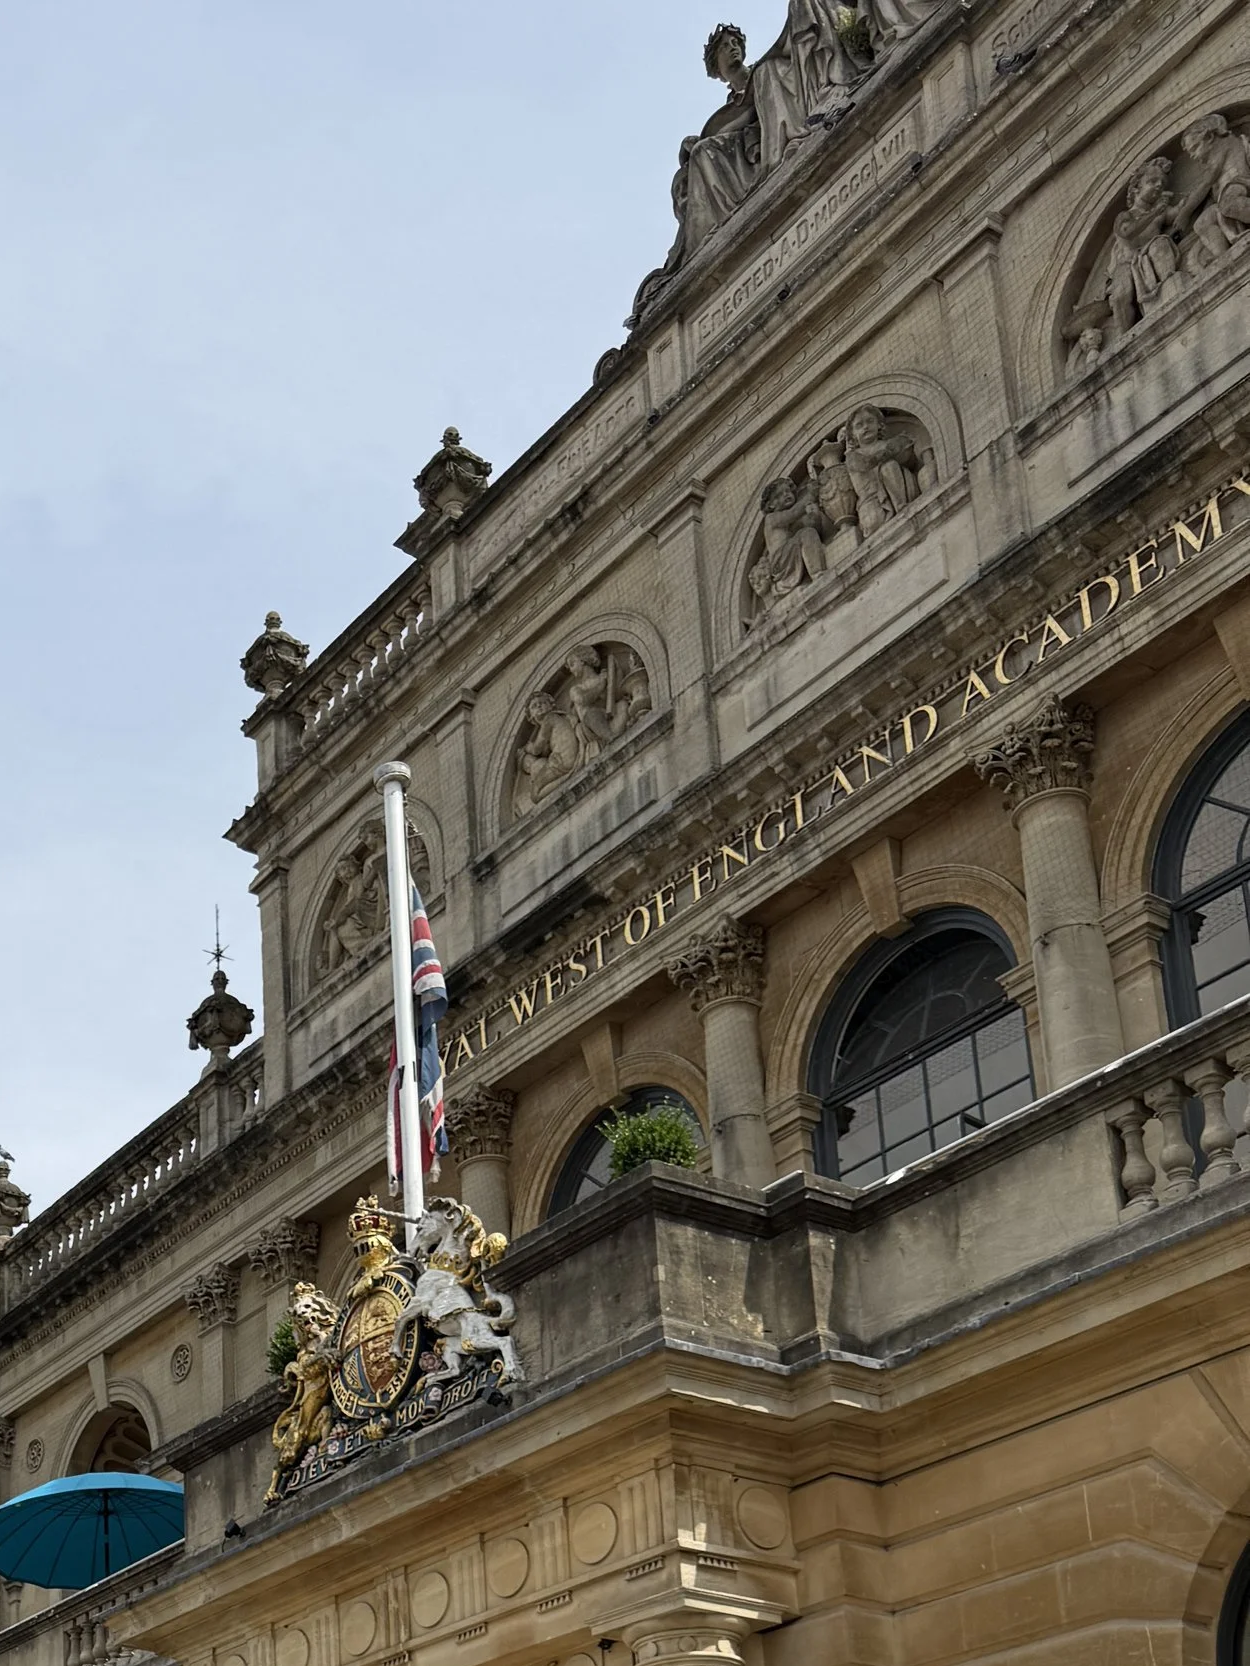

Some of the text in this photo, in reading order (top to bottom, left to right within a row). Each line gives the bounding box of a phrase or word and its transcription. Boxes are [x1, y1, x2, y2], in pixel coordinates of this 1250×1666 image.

[438, 1018, 501, 1078] YAL
[509, 930, 610, 1025] WEST
[623, 883, 676, 945] OF
[689, 705, 938, 903] ENGLAND
[344, 1430, 364, 1452] ET
[396, 1399, 426, 1427] MON
[441, 1370, 489, 1411] DROIT
